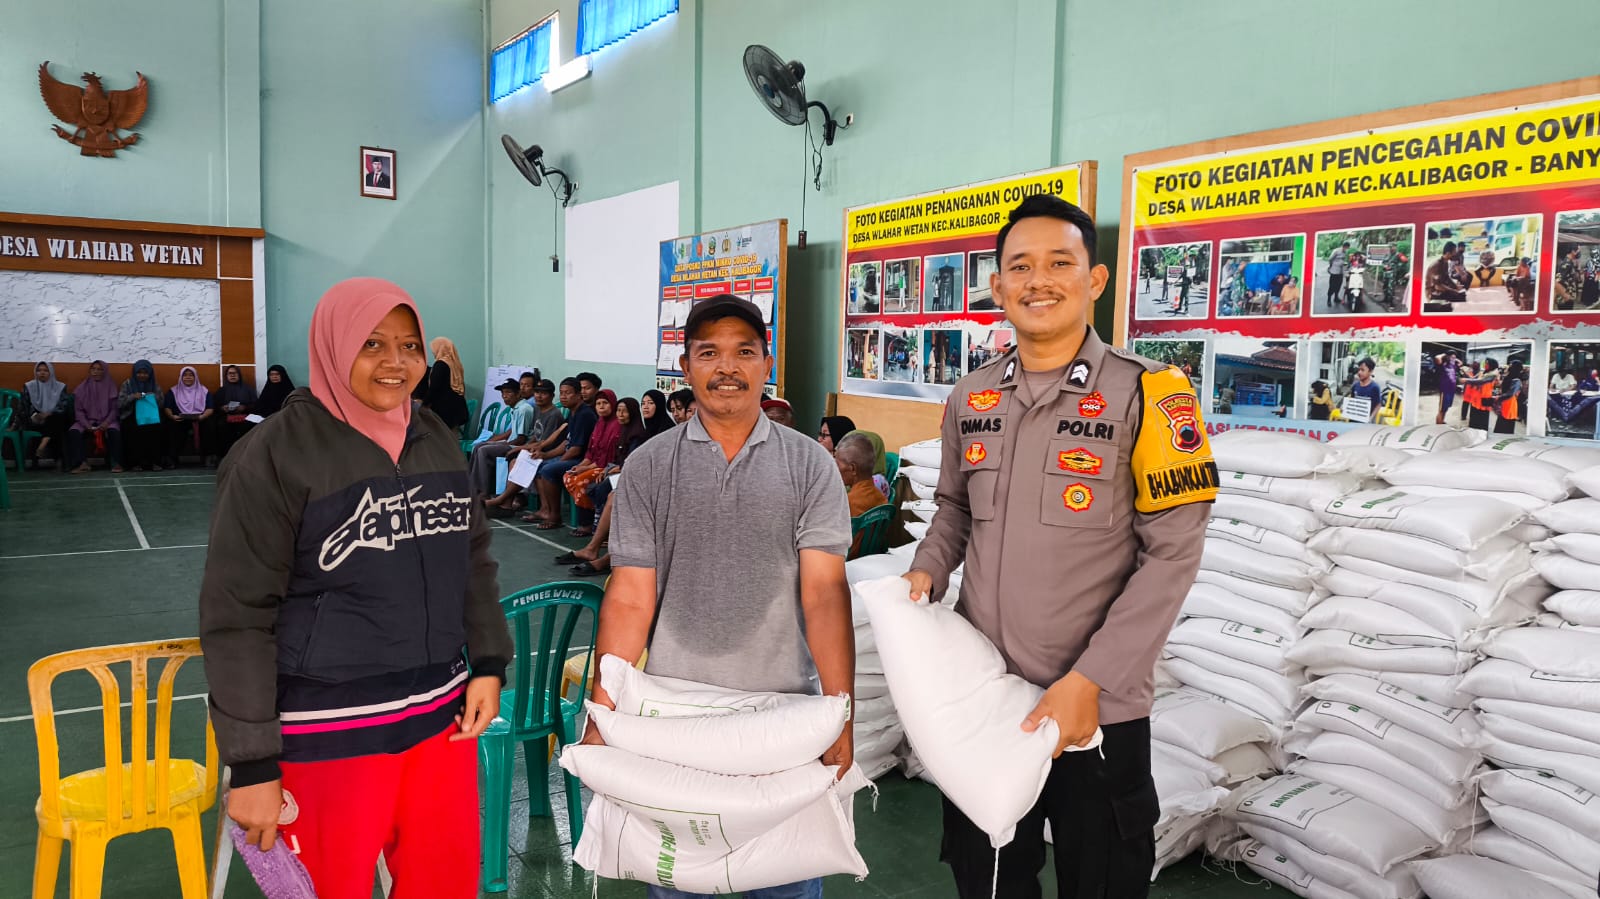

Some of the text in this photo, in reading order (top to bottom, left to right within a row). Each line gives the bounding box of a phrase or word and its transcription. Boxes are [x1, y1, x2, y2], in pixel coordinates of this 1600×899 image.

[1154, 110, 1600, 193] FOTO KEGIATAN PENCEGAHAN COVI
[1148, 200, 1186, 217] DESA
[1192, 189, 1260, 212] WLAHAR
[1266, 181, 1328, 202] WETAN
[1334, 159, 1508, 195] KEC.KALIBAGOR
[1530, 148, 1600, 174] BANY
[855, 178, 1064, 228] FOTO KEGIATAN PENANGANAN COVID-19
[853, 231, 870, 244] DESA
[872, 226, 902, 241] WLAHAR
[904, 222, 929, 236] WETAN
[931, 212, 1001, 233] KEC.KALIBAGOR
[47, 238, 135, 263] WLAHAR
[140, 243, 204, 266] WETAN
[733, 253, 757, 265] COVID-19
[731, 264, 762, 277] KALIBAGOR
[961, 417, 1002, 435] DIMAS
[1057, 419, 1115, 441] POLRI
